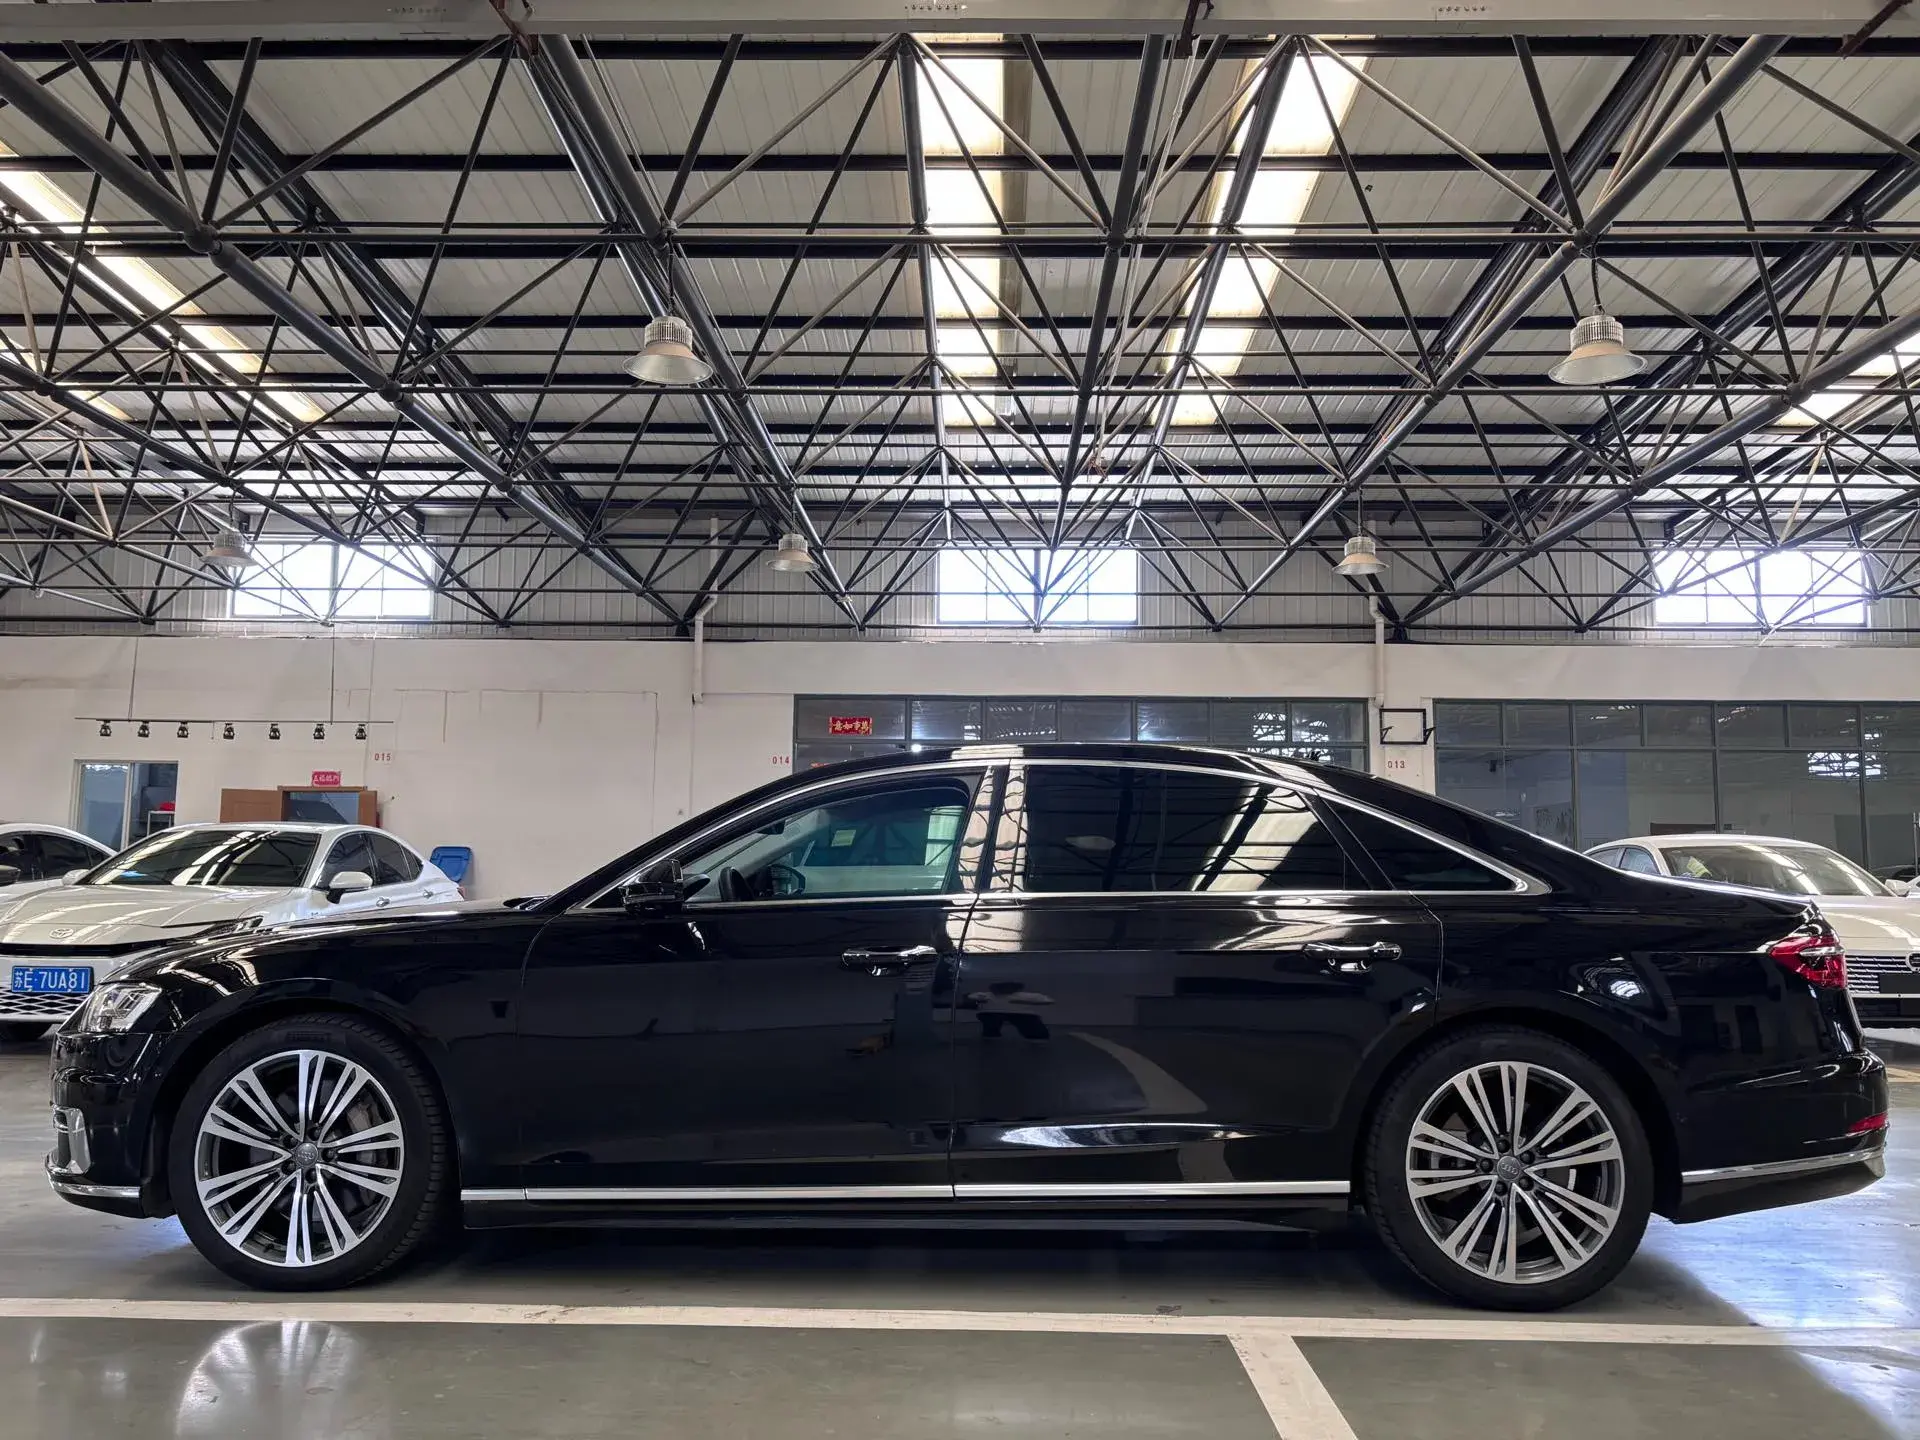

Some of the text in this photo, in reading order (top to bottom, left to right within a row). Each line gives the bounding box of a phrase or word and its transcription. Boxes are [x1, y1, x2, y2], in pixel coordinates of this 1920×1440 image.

[374, 752, 391, 761] 015
[772, 756, 790, 765] 014
[1387, 760, 1405, 769] 013
